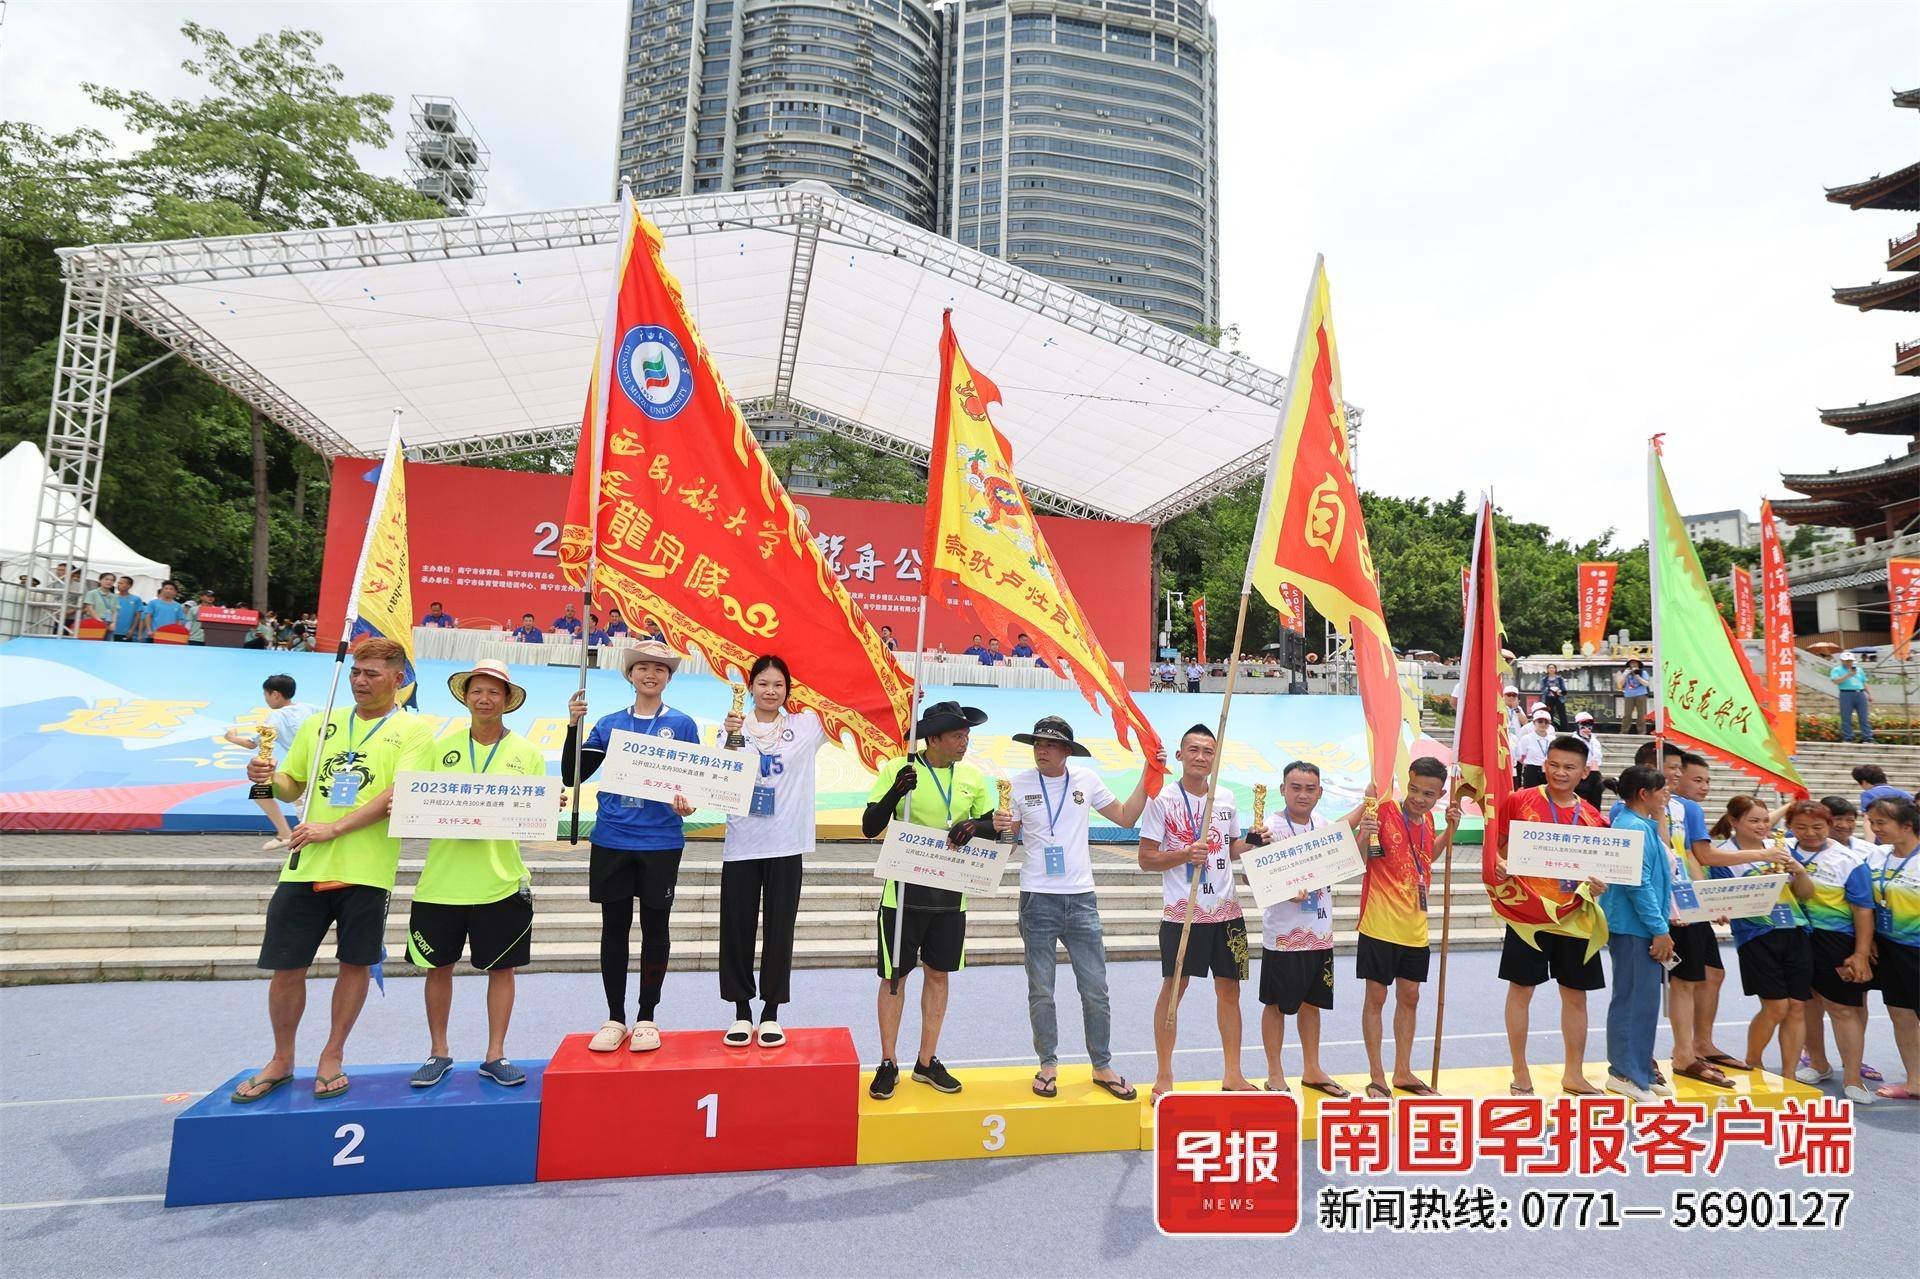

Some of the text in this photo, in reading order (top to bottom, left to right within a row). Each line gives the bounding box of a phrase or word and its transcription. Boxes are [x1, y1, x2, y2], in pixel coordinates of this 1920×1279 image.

[649, 386, 687, 415] UNIVERSITY
[622, 741, 744, 773] 2023年南宁龙舟公开赛
[410, 781, 546, 797] 2023年南宁龙舟公开赛
[1255, 831, 1344, 868] 2023年南宁龙舟公开赛
[1522, 830, 1631, 848] 2023年南宁龙舟公开赛
[412, 930, 434, 956] SPORT
[697, 1093, 719, 1139] 1
[332, 1123, 366, 1166] 2
[982, 1114, 1007, 1151] 3
